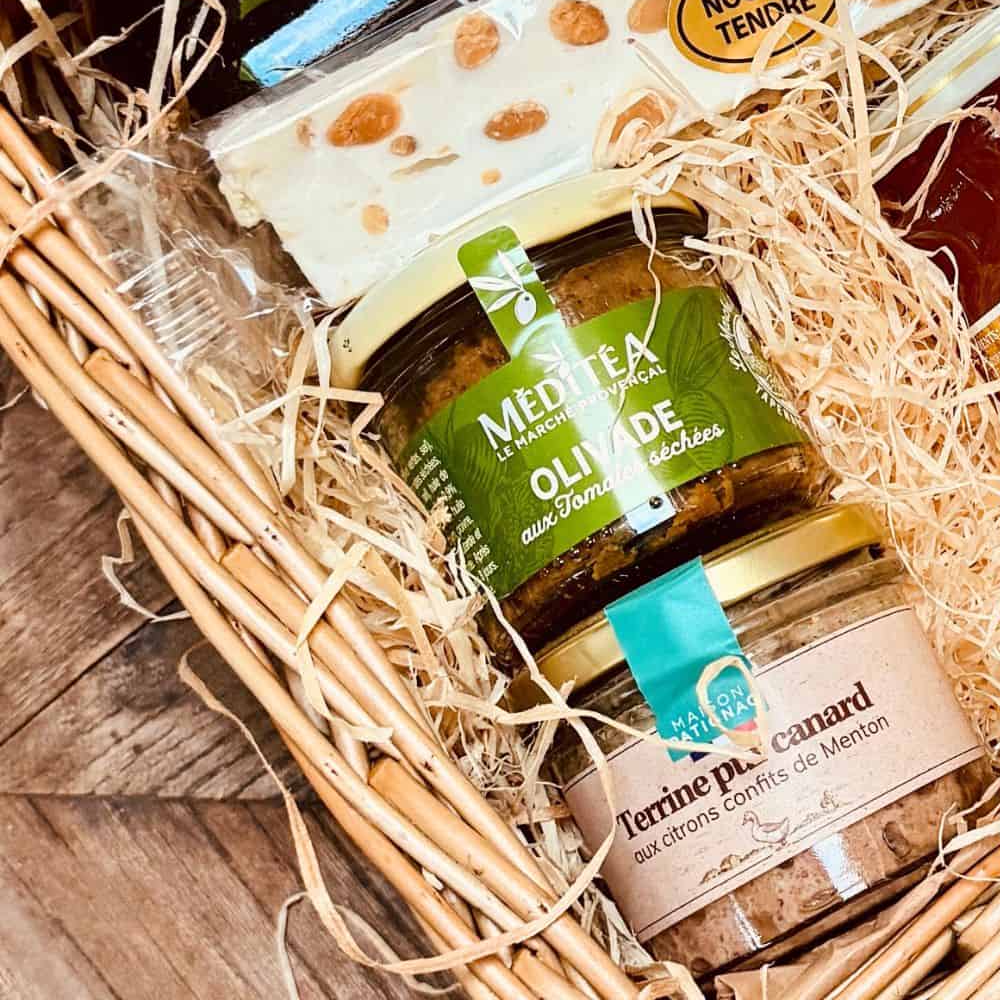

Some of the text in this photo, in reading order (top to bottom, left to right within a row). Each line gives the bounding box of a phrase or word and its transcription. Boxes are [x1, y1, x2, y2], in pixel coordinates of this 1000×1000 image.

[497, 447, 515, 463] LE
[521, 510, 558, 545] aux
[649, 422, 726, 467] séchées
[529, 398, 685, 502] OLIVADE
[615, 680, 875, 841] Terrine pu canard
[634, 712, 890, 865] aux citrons confits de Menton
